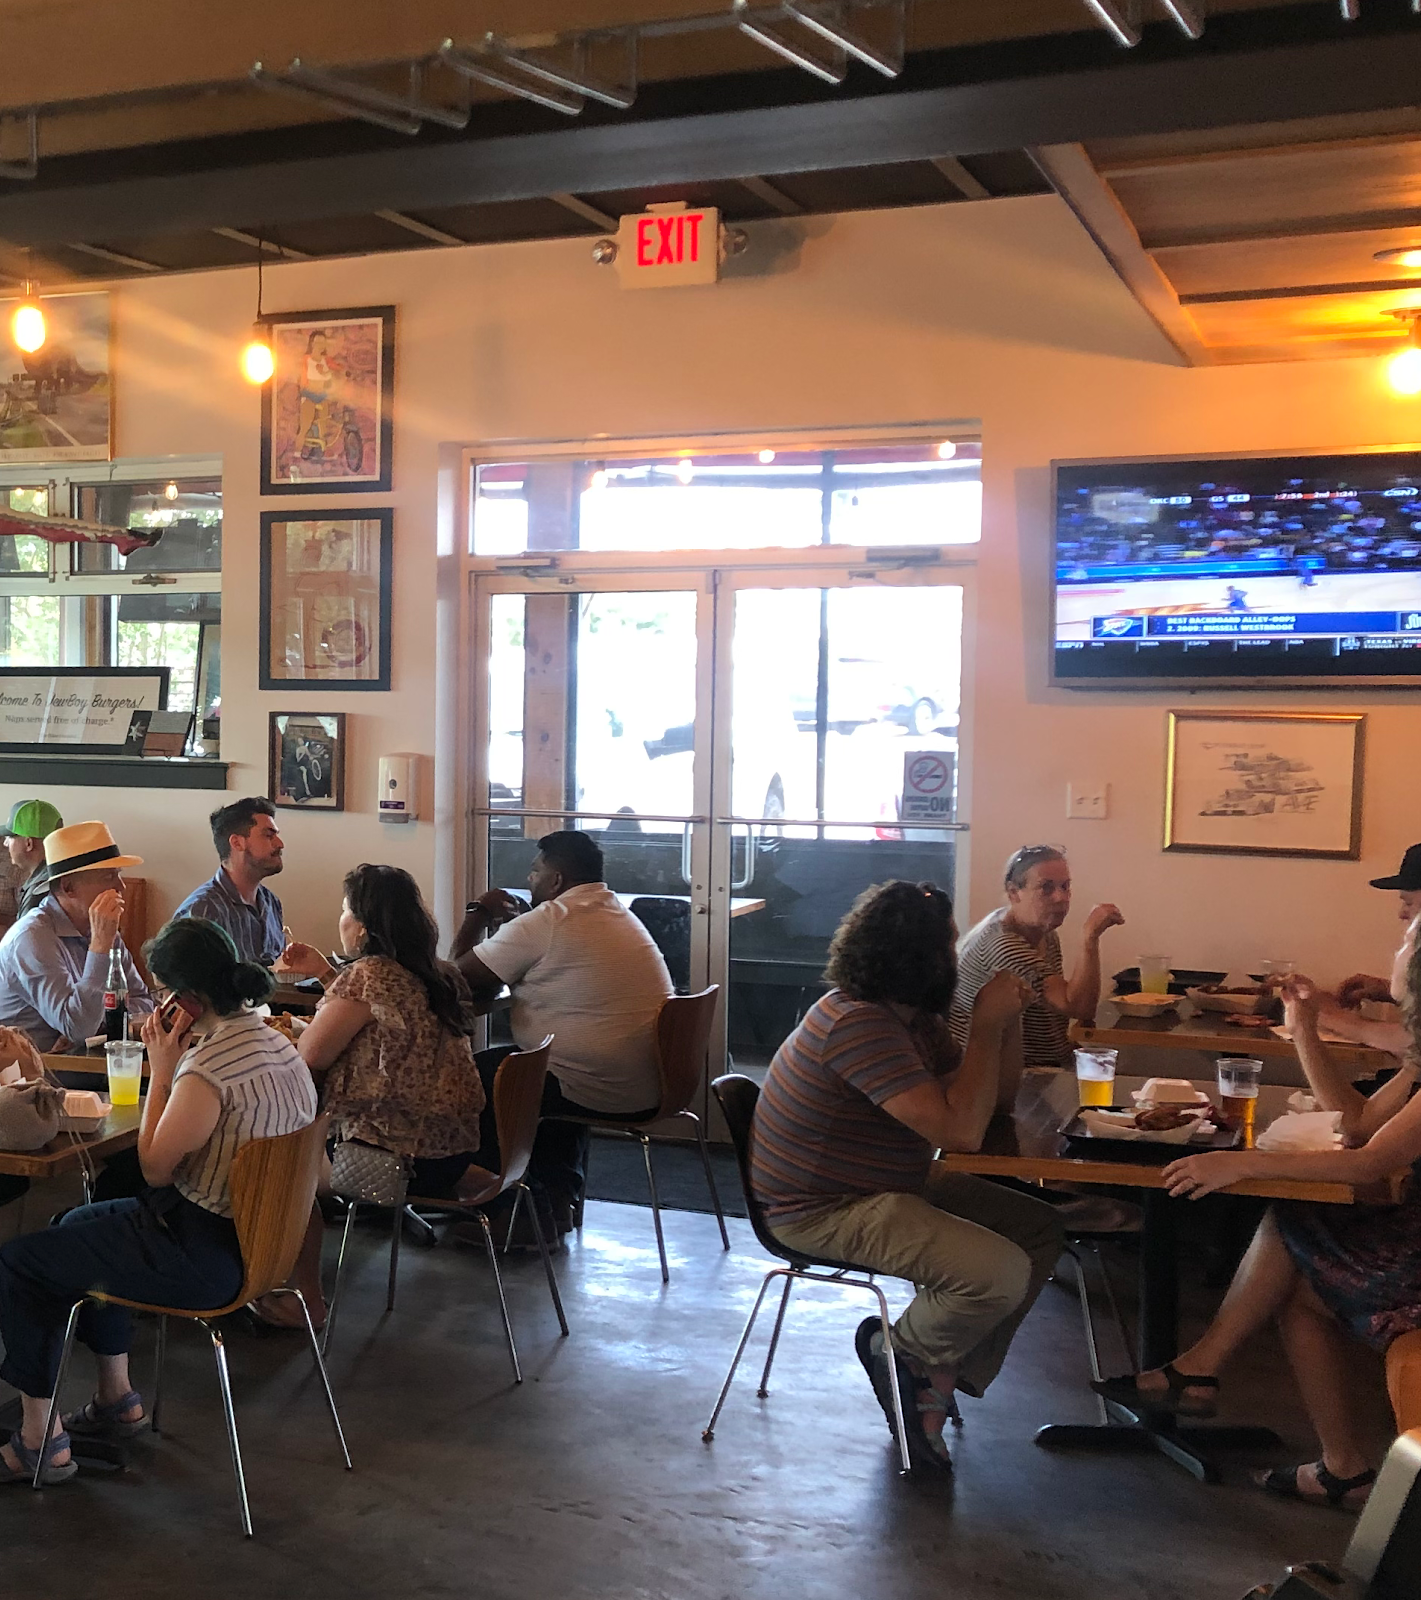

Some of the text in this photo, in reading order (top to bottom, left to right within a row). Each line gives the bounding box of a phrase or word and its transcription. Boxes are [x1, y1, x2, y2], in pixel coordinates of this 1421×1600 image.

[637, 213, 704, 267] EXIT
[1314, 491, 1330, 499] 2nd
[1189, 616, 1241, 624] BACKBOARD
[1203, 624, 1239, 632] RUSSELL
[1240, 623, 1295, 631] WESTBROOK
[32, 692, 42, 706] To
[91, 694, 145, 714] Burgers!
[26, 715, 51, 723] servd
